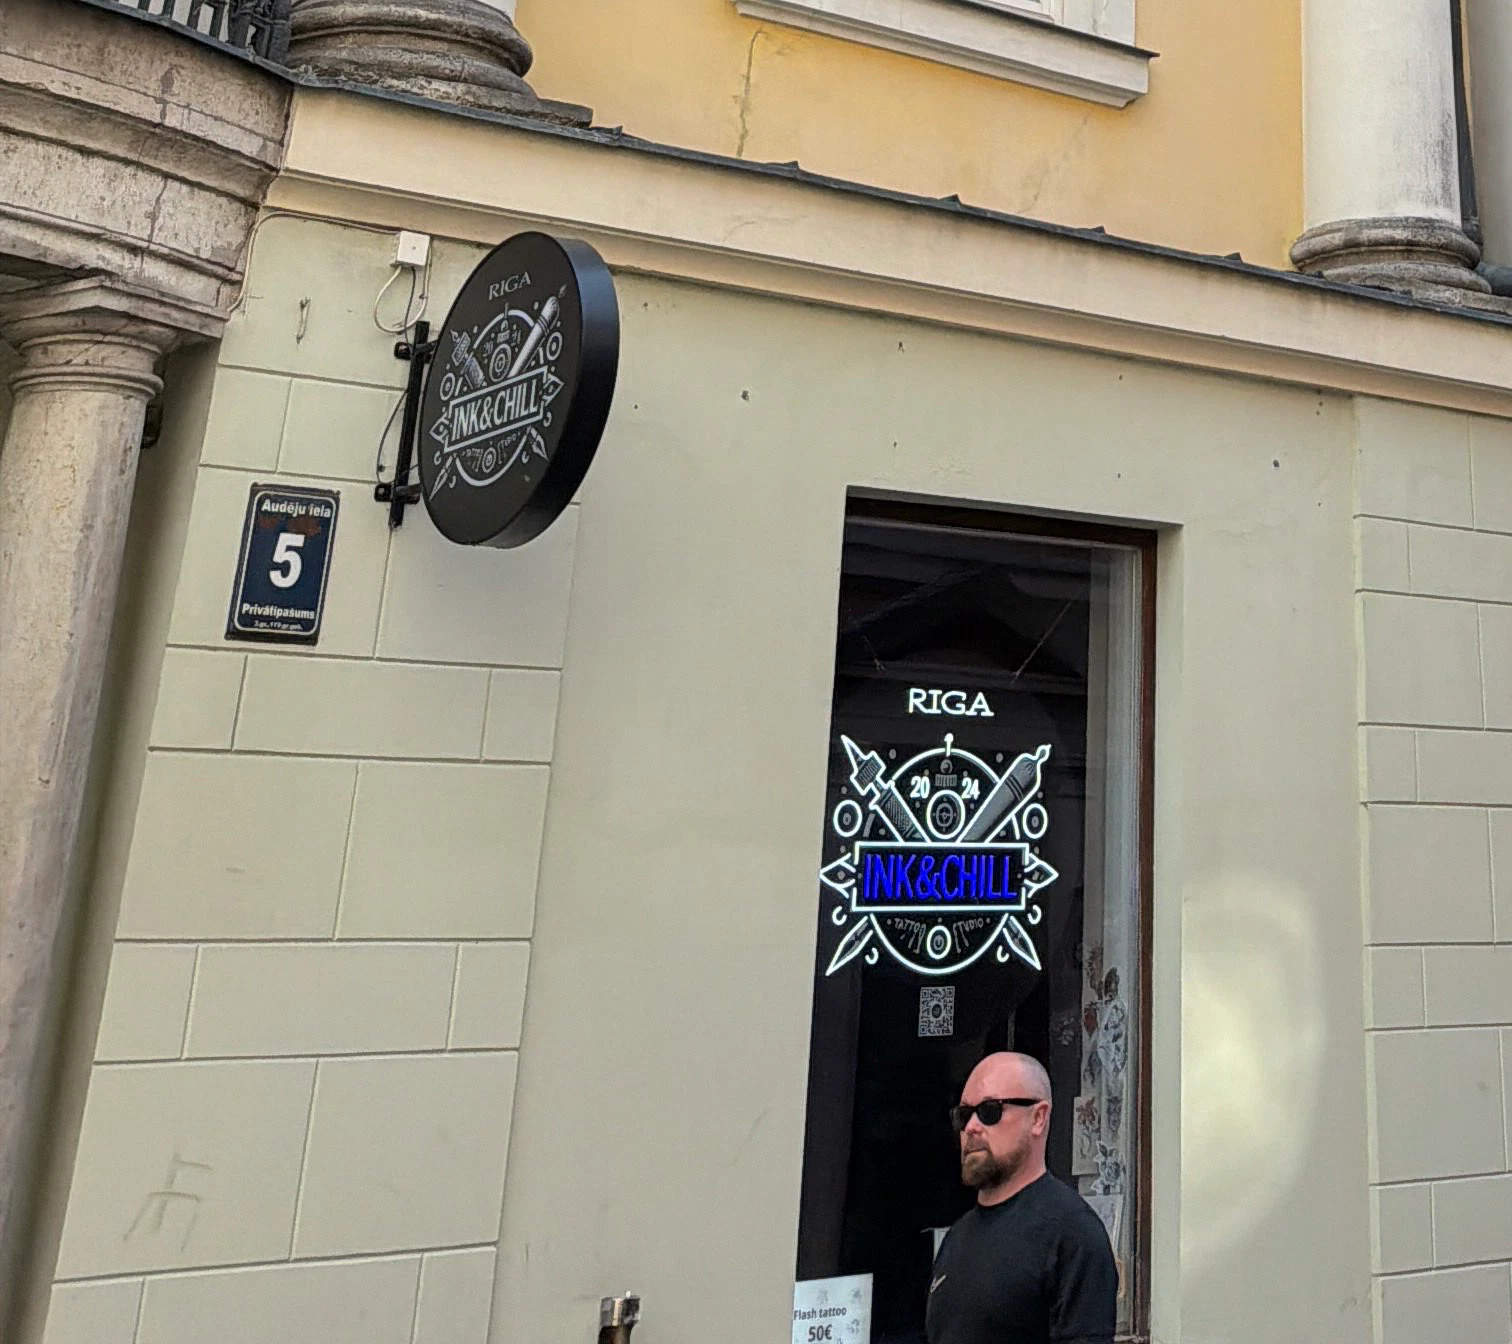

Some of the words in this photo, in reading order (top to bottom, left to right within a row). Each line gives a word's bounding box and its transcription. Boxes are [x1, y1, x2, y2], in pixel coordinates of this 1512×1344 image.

[488, 271, 532, 300] RIGA
[451, 378, 538, 442] INK&CHILL
[261, 499, 306, 517] Audēju
[309, 503, 331, 518] iela
[269, 532, 305, 588] 5
[908, 688, 994, 716] RIGA
[910, 775, 930, 799] 20
[961, 776, 980, 800] 24
[863, 853, 1018, 900] INK&CHILL
[793, 1309, 818, 1321] Flash
[818, 1306, 848, 1318] tattoo
[808, 1324, 833, 1343] 50€
